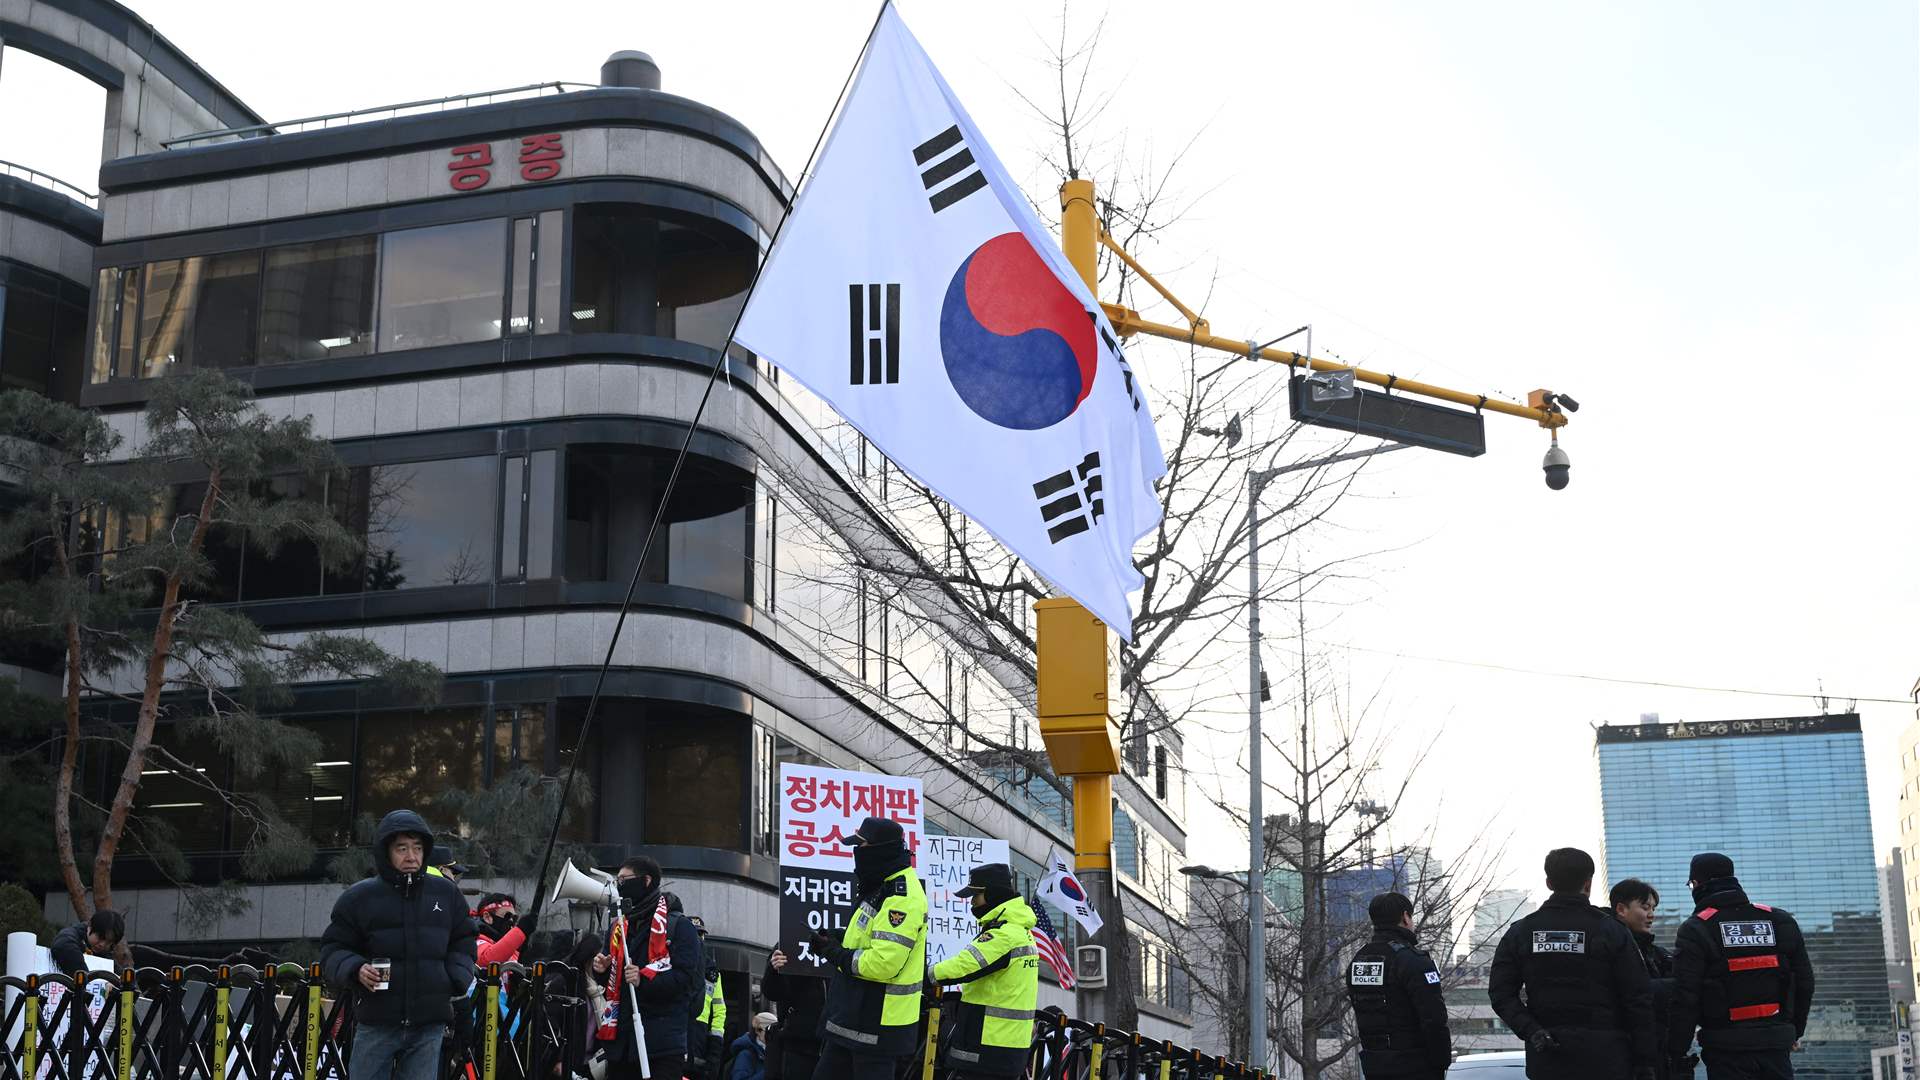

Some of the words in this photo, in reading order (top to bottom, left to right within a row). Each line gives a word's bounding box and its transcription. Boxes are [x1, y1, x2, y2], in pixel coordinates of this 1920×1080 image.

[448, 133, 565, 191] 공증
[785, 775, 920, 825] 정치재판
[927, 837, 984, 864] 지귀연
[784, 876, 852, 907] 지귀연
[928, 863, 972, 888] 판사
[1537, 943, 1578, 952] POLICE
[1730, 936, 1768, 944] POLICE
[119, 1018, 127, 1075] POLICE
[306, 1013, 315, 1071] POLICE
[485, 1013, 493, 1073] POLICE
